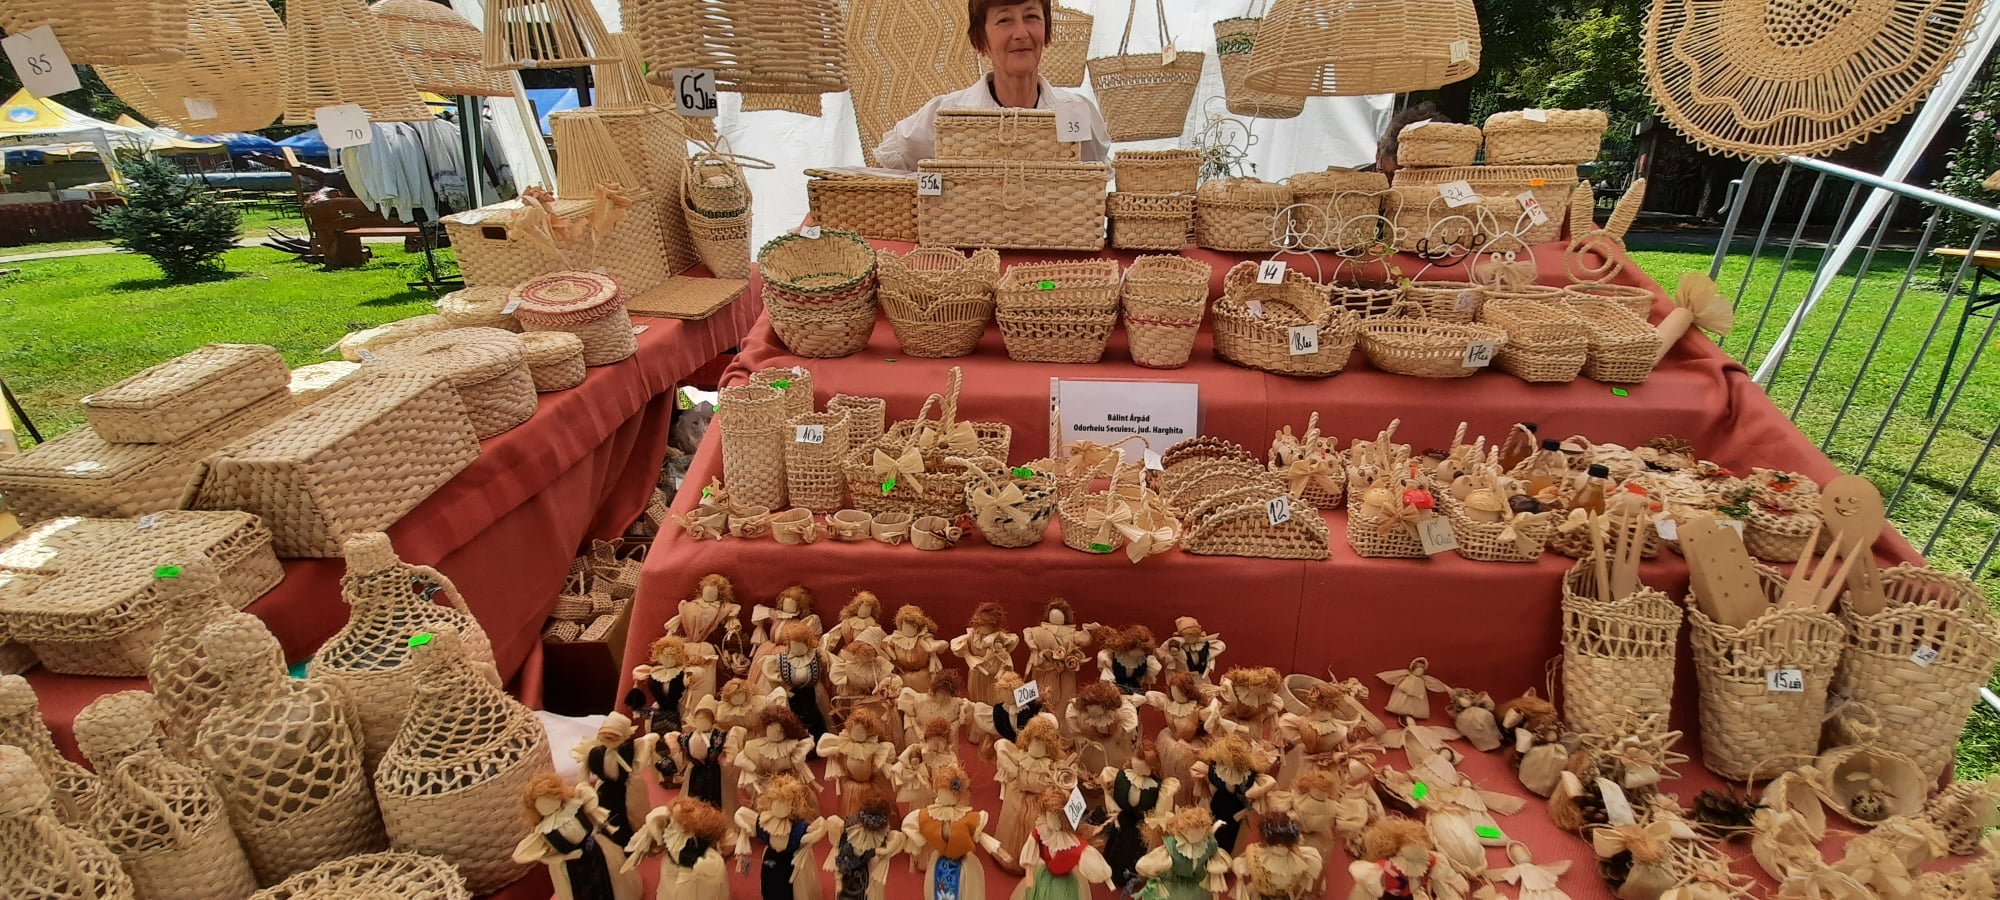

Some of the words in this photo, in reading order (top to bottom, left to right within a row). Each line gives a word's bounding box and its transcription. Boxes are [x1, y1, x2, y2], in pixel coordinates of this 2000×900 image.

[28, 54, 52, 75] 85
[1068, 121, 1079, 132] 35
[346, 129, 363, 141] 70
[1107, 413, 1128, 422] Bálint
[1130, 413, 1150, 423] Árpád
[1073, 424, 1104, 432] Odorheiu
[1106, 424, 1136, 433] Secuiesc,
[1138, 425, 1151, 434] jud.
[1153, 426, 1183, 435] Harghita
[1270, 500, 1287, 522] 12
